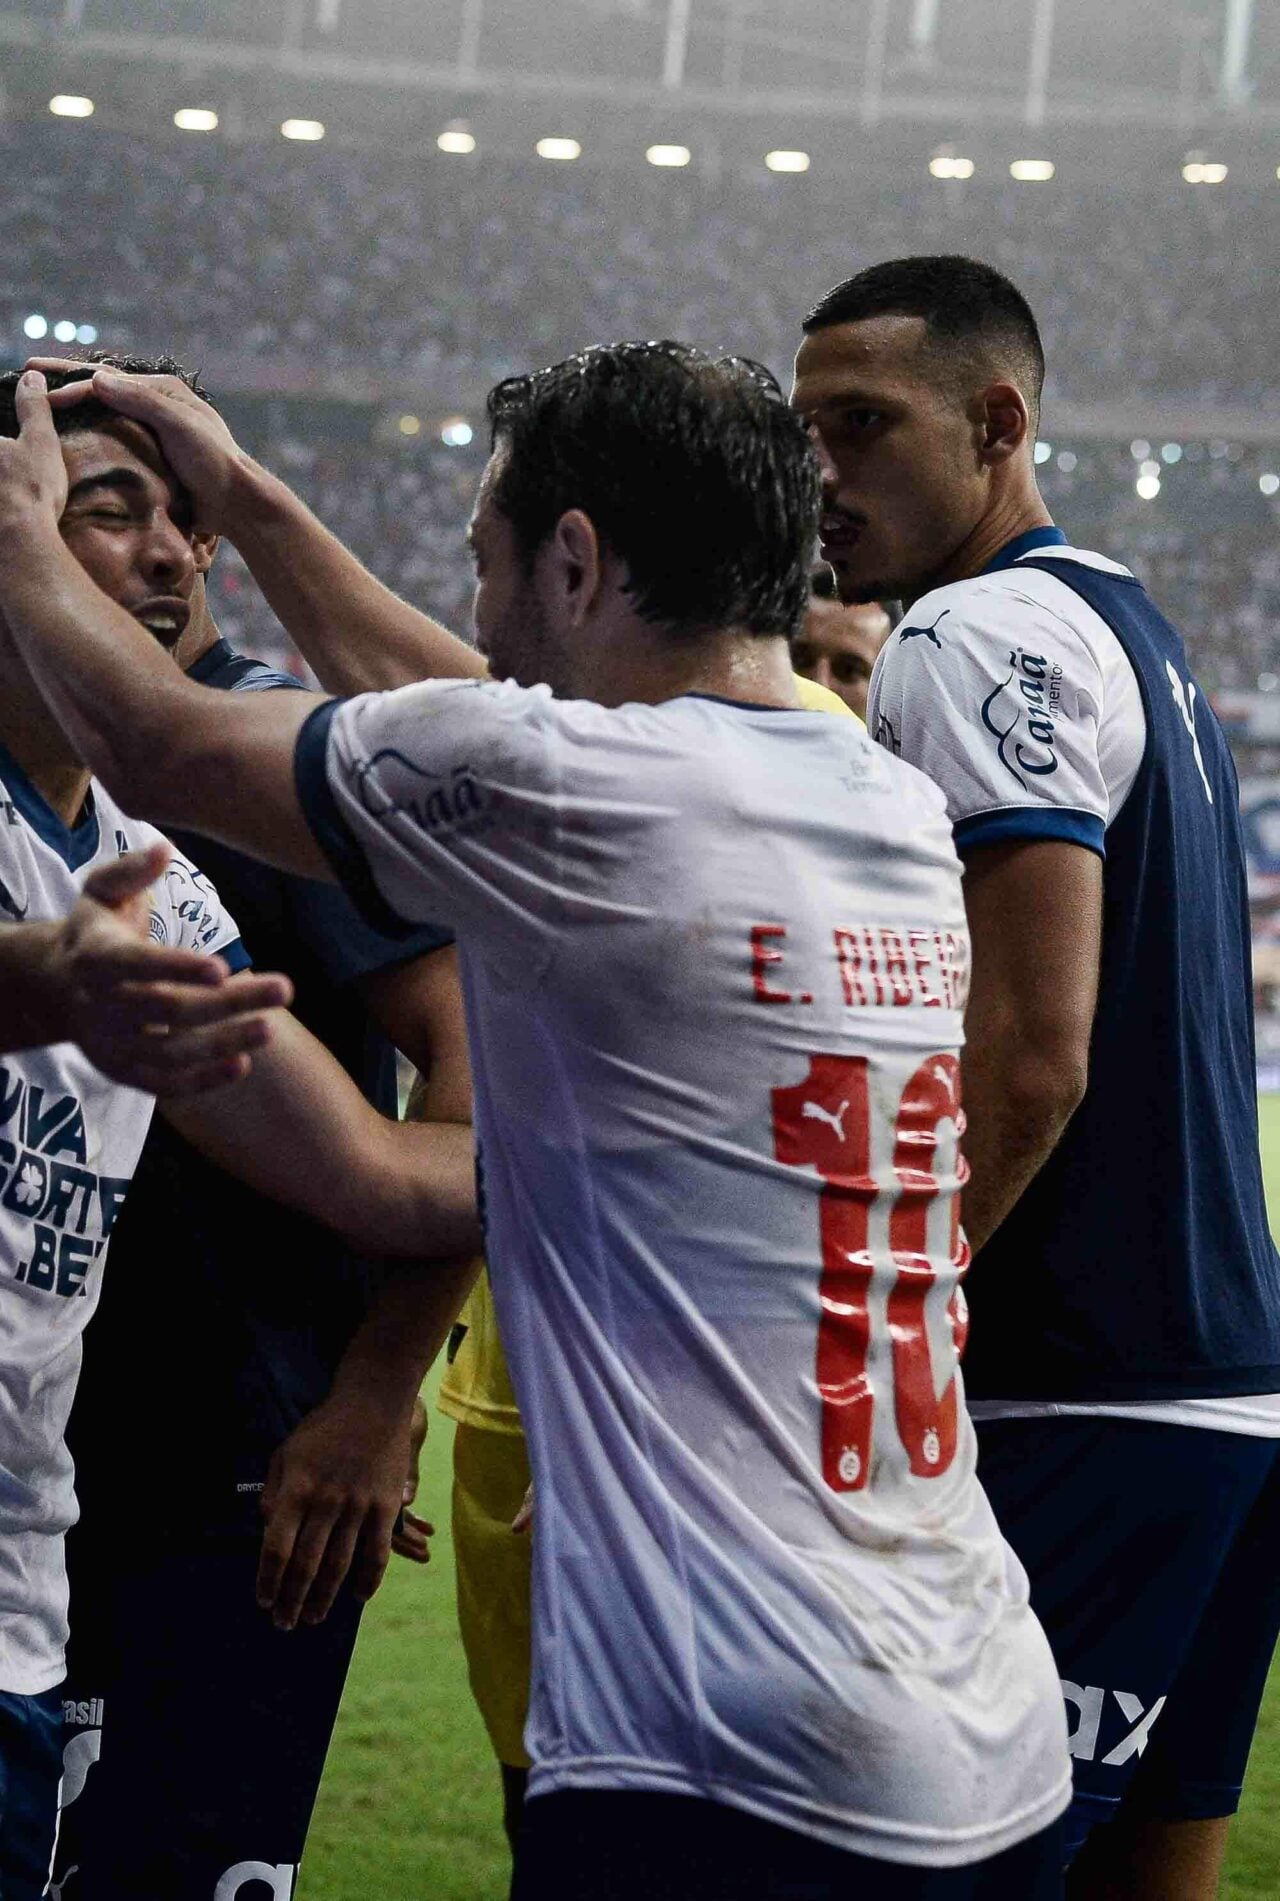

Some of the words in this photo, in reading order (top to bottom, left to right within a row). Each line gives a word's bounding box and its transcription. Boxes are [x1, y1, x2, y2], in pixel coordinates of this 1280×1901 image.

[750, 926, 813, 1004] E.
[771, 1054, 970, 1492] 10
[62, 1698, 104, 1726] asil
